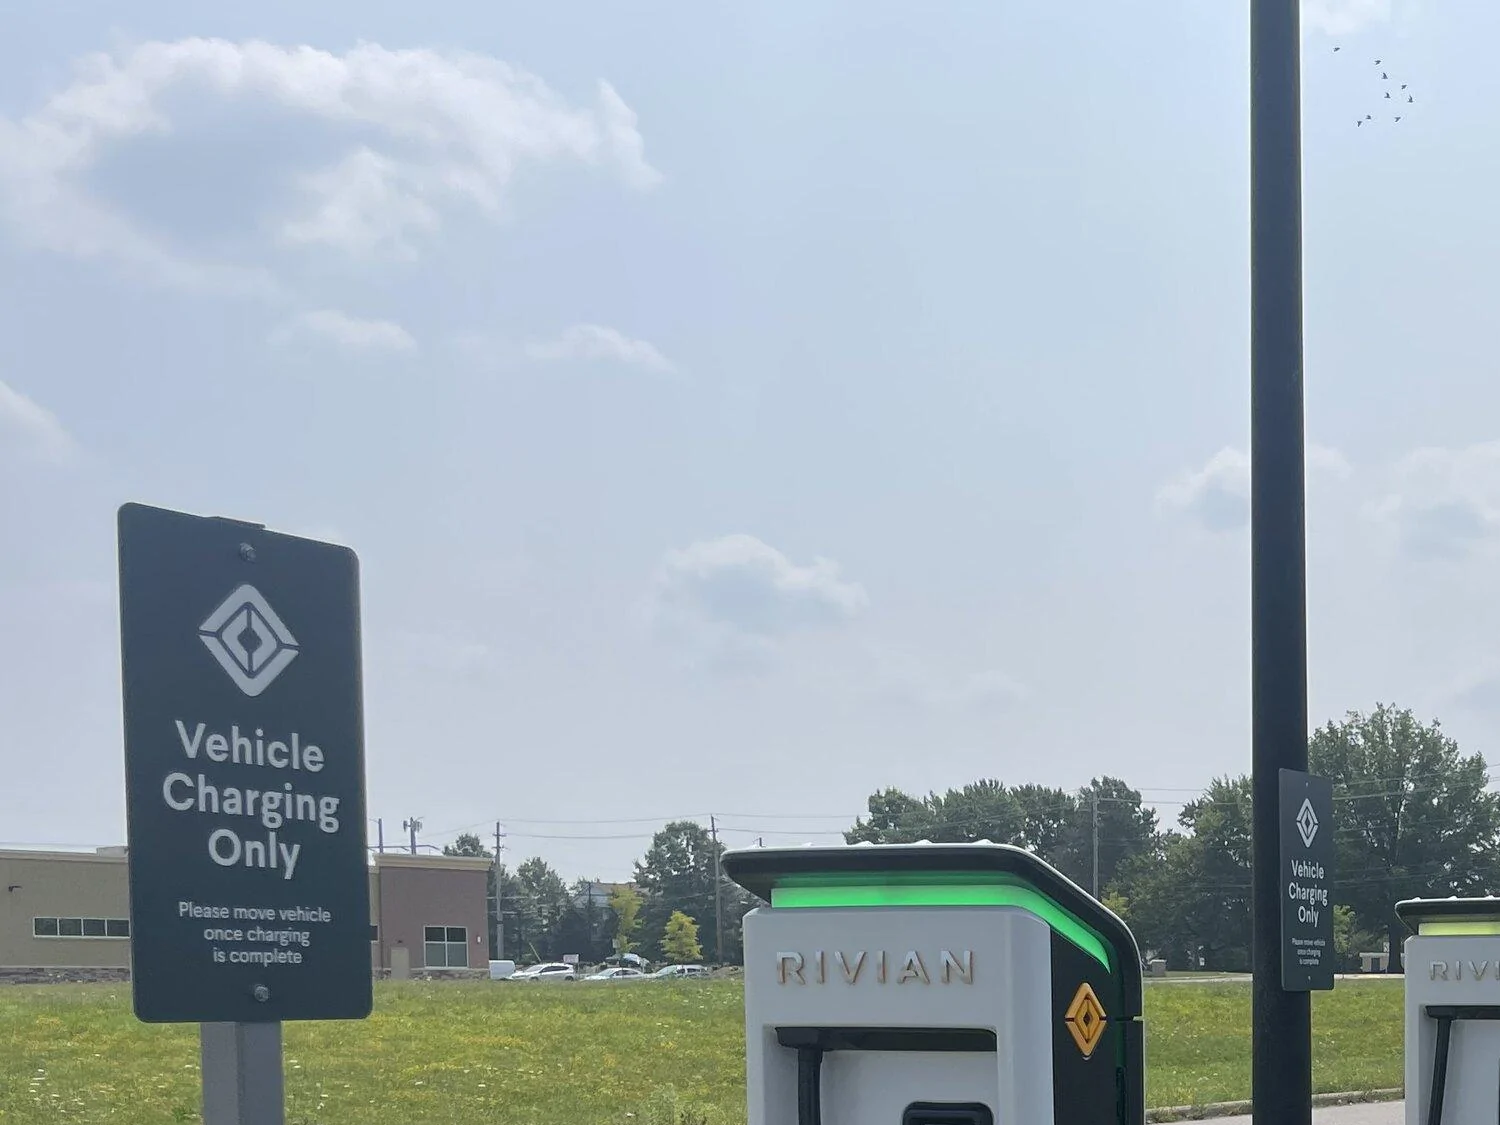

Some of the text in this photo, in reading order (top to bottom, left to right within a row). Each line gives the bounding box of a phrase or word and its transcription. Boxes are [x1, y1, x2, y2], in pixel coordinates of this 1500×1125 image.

[174, 719, 325, 773] Vehicle
[163, 772, 340, 833] Charging
[208, 828, 301, 880] Only
[1291, 859, 1325, 880] Vehicle
[1288, 882, 1328, 906] Charging
[178, 901, 332, 923] Please move vehicle
[1298, 905, 1319, 928] Only
[203, 926, 311, 947] once charging
[213, 947, 302, 967] is complete
[776, 949, 975, 986] RIVIAN
